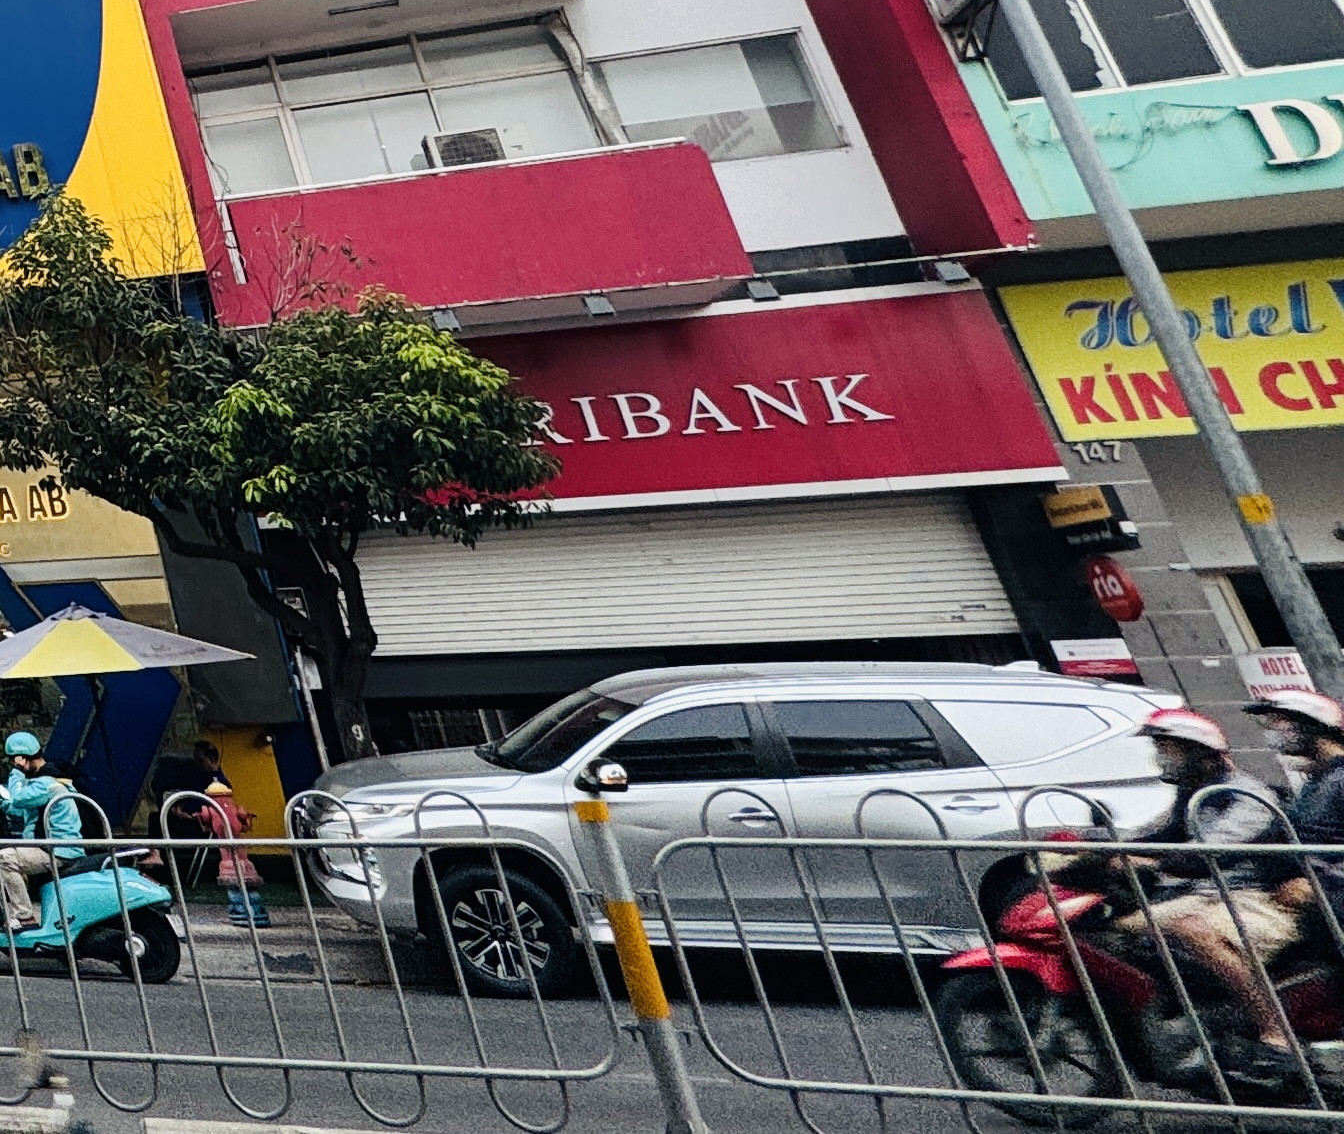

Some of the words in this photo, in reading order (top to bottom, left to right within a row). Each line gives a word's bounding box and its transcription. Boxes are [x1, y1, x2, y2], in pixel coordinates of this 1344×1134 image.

[519, 373, 895, 447] RIBANK
[1072, 441, 1123, 464] 147
[27, 481, 70, 522] AB
[1258, 656, 1305, 675] HOTEL
